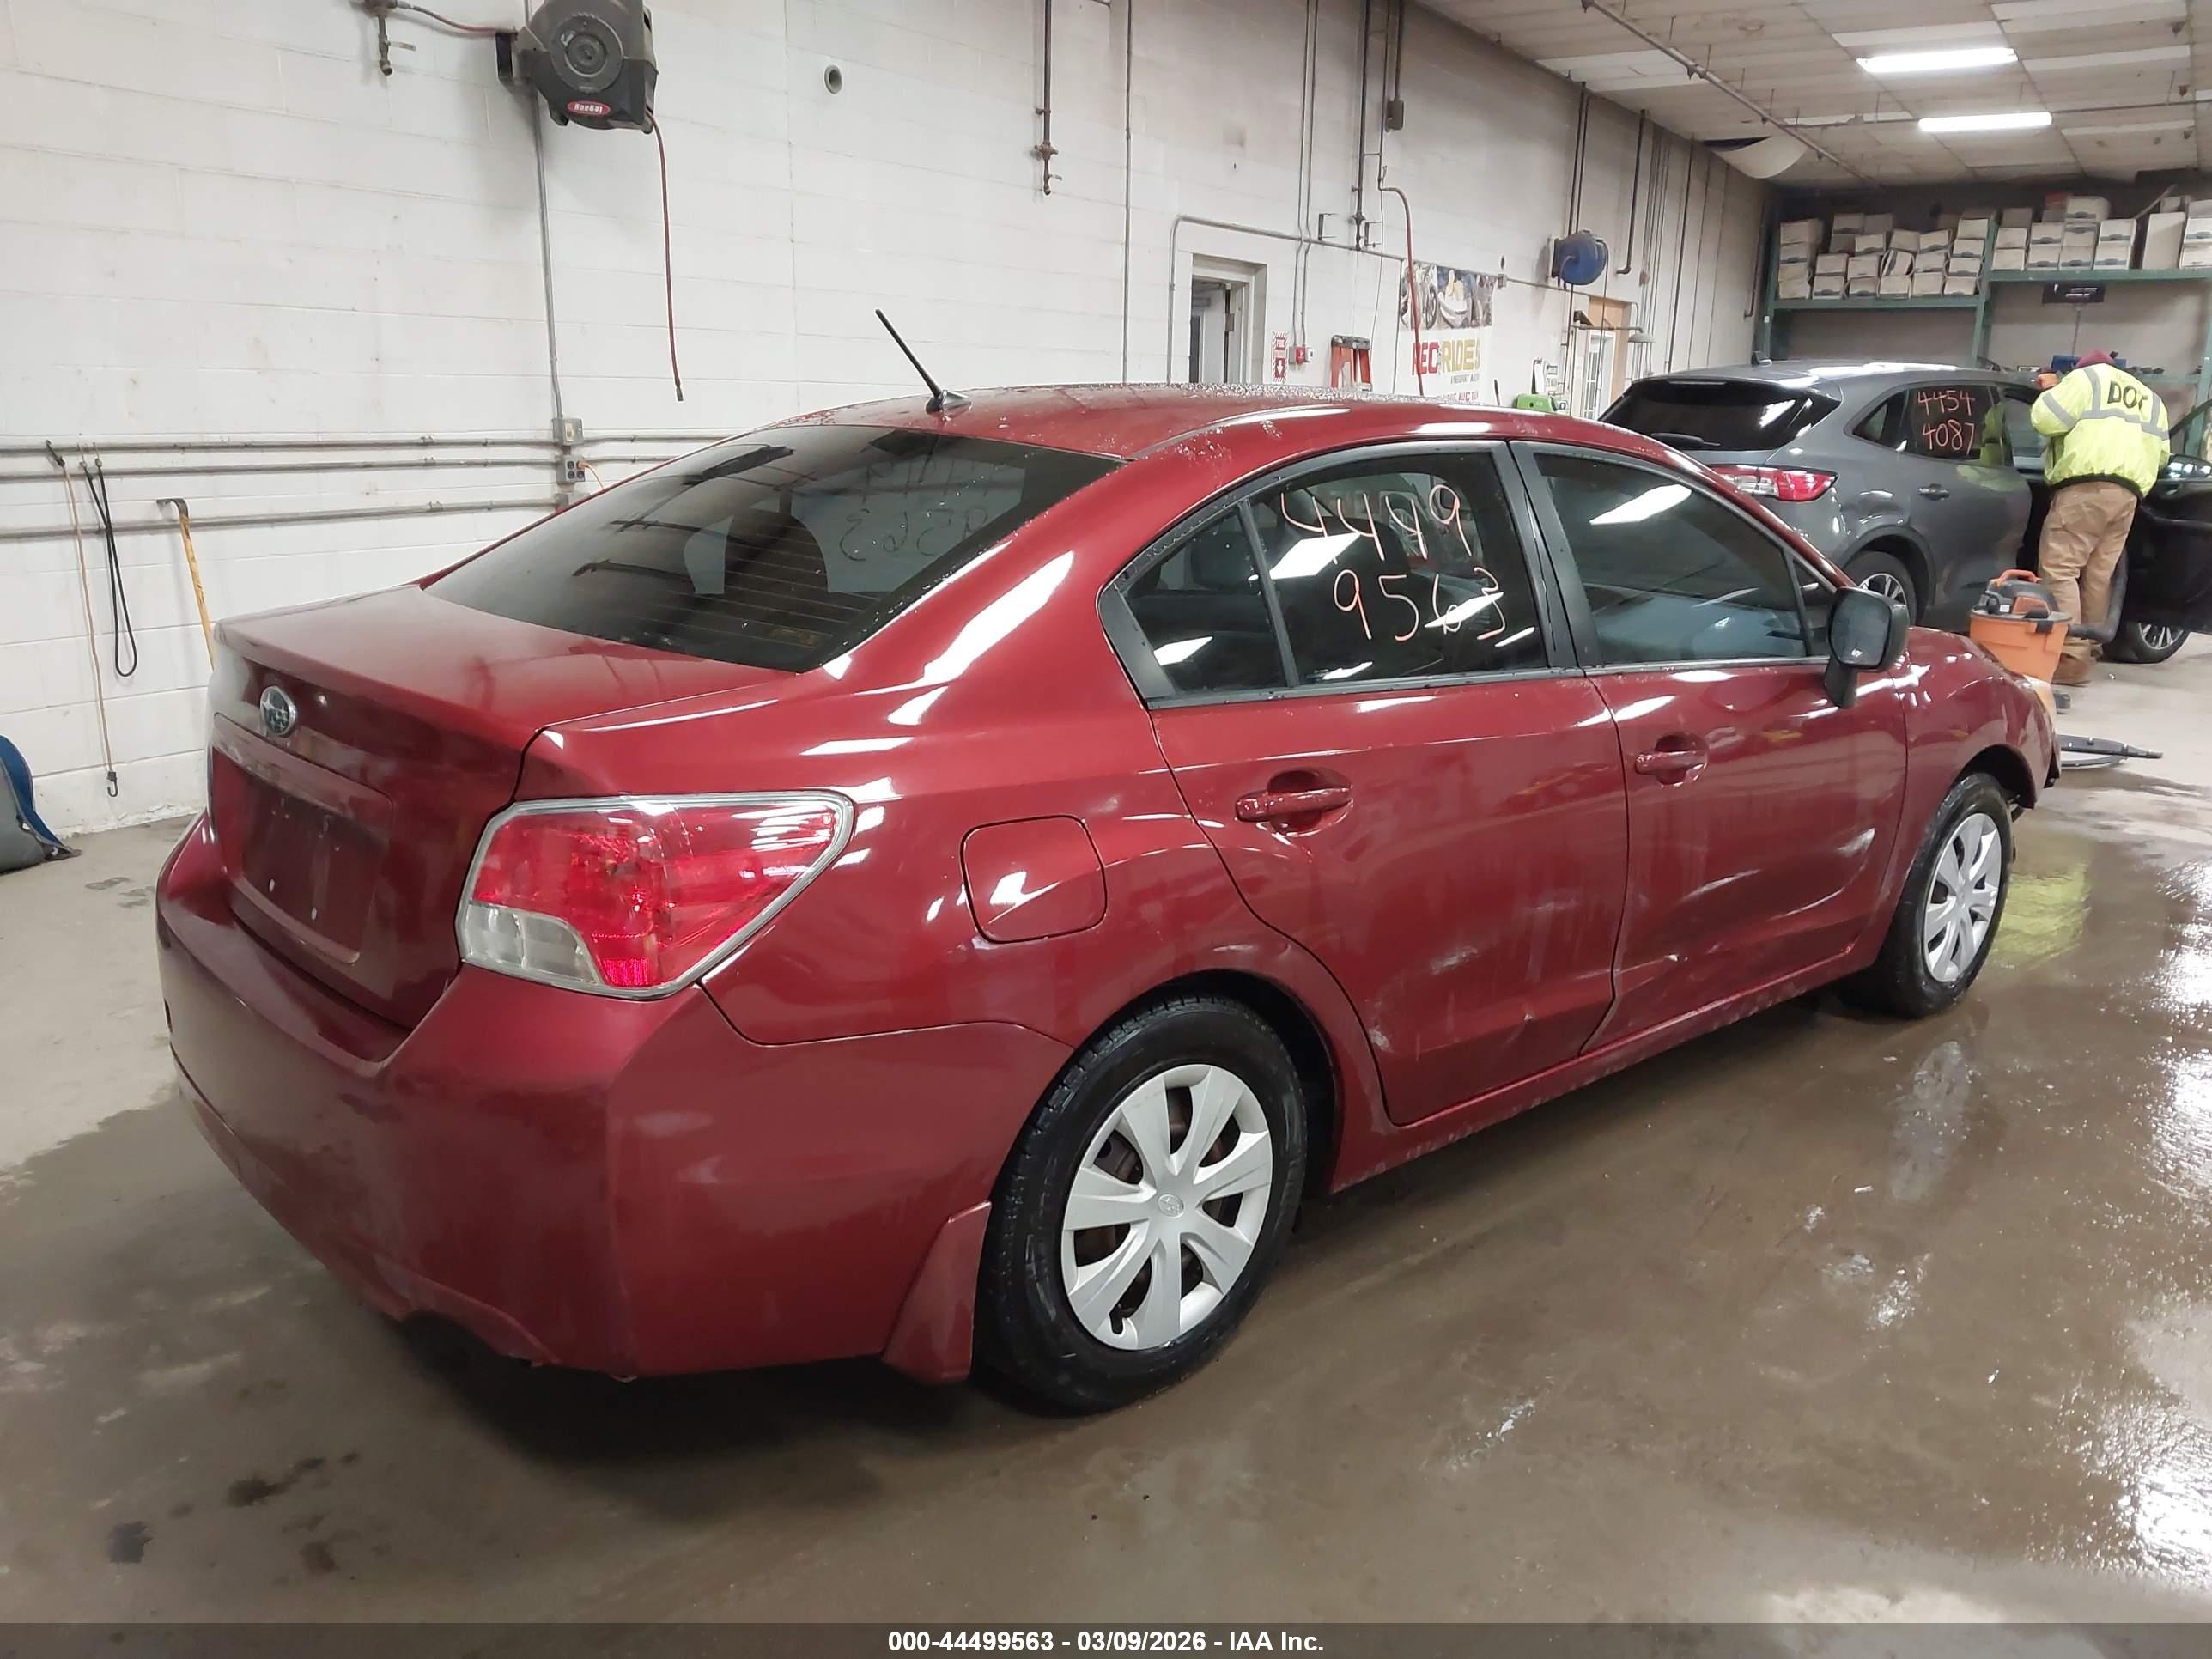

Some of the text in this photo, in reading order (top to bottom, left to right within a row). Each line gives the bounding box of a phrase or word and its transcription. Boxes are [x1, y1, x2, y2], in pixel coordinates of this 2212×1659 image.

[1917, 389, 1976, 416] 4454
[1923, 419, 1975, 455] 4087
[1333, 567, 1507, 641] 9563
